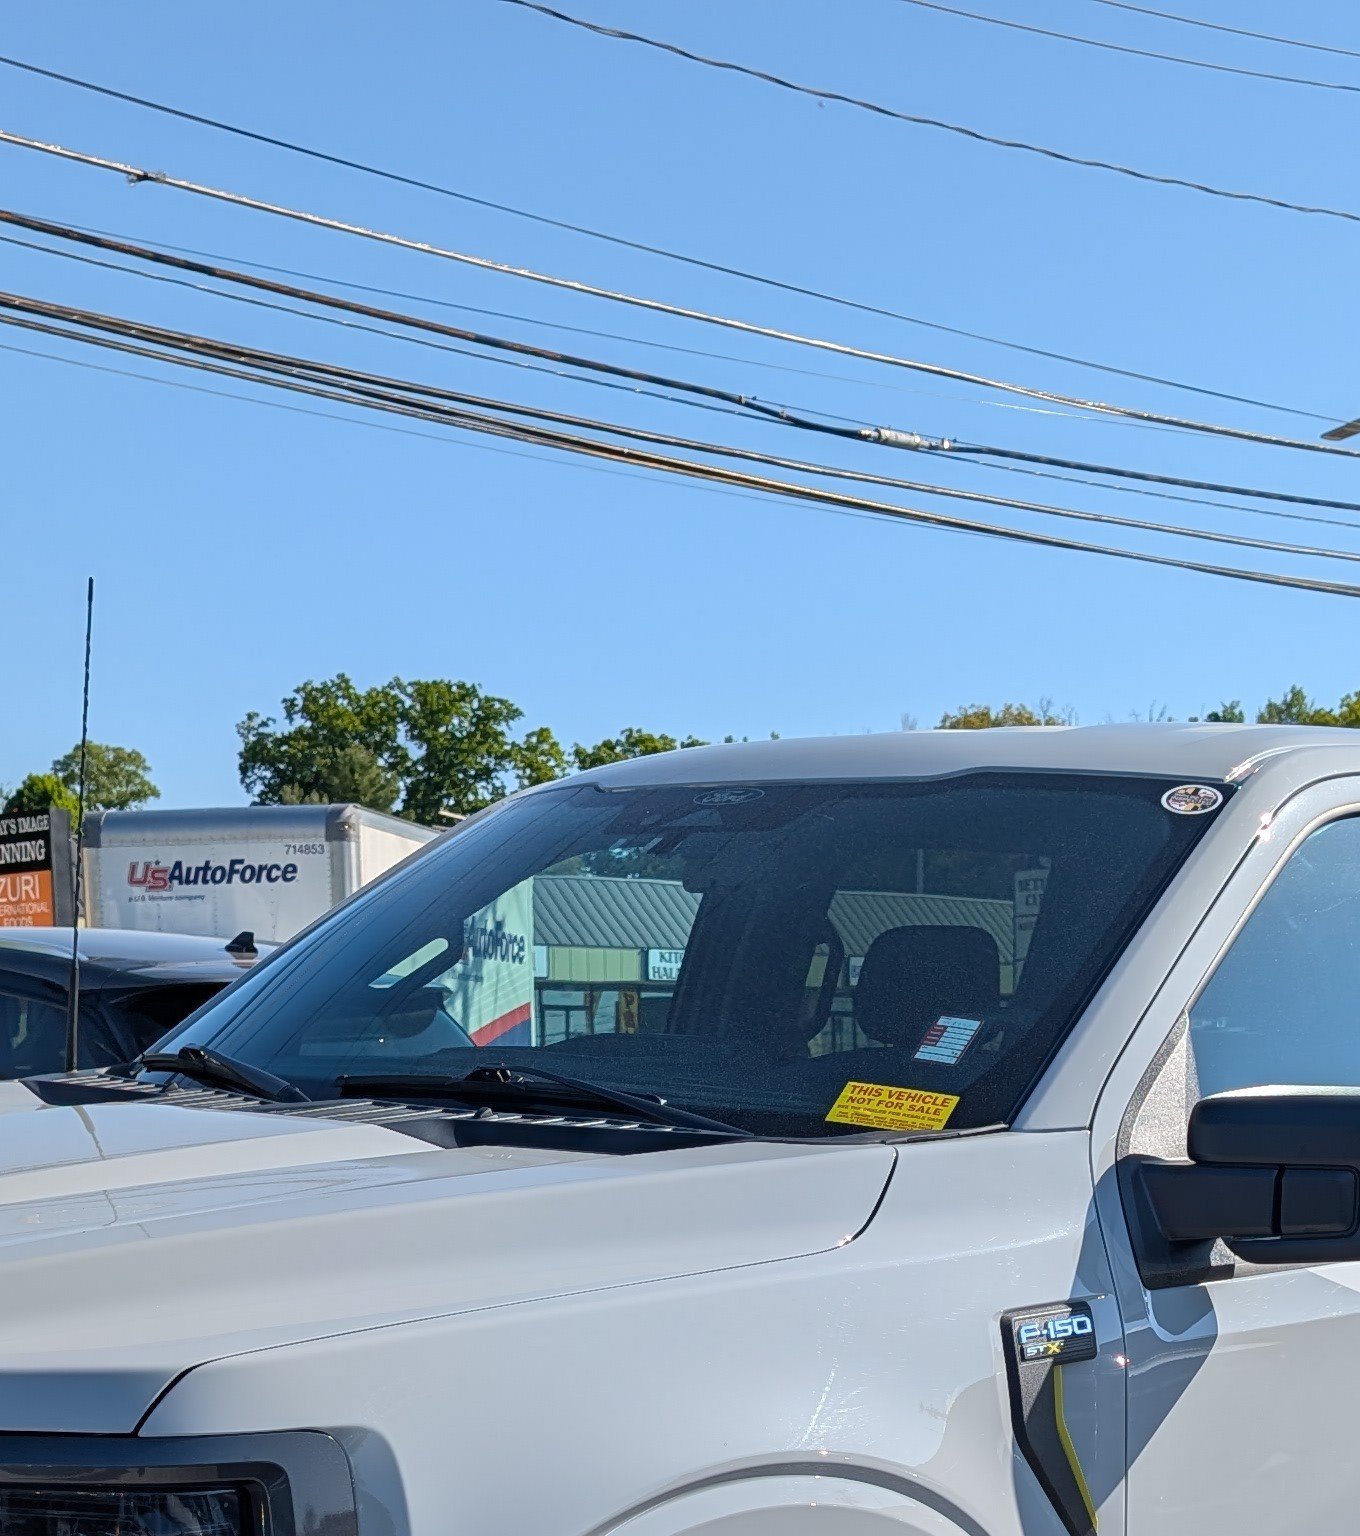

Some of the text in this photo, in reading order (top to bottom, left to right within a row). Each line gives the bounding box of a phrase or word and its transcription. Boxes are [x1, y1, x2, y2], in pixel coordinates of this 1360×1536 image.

[17, 815, 49, 833] IMAGE
[284, 844, 325, 855] 714853
[168, 859, 298, 886] AutoForce
[846, 1096, 943, 1116] NOT FOR SALE
[851, 1084, 953, 1108] THIS VEHICLE
[1021, 1316, 1093, 1344] F-150
[1026, 1342, 1061, 1356] STX
